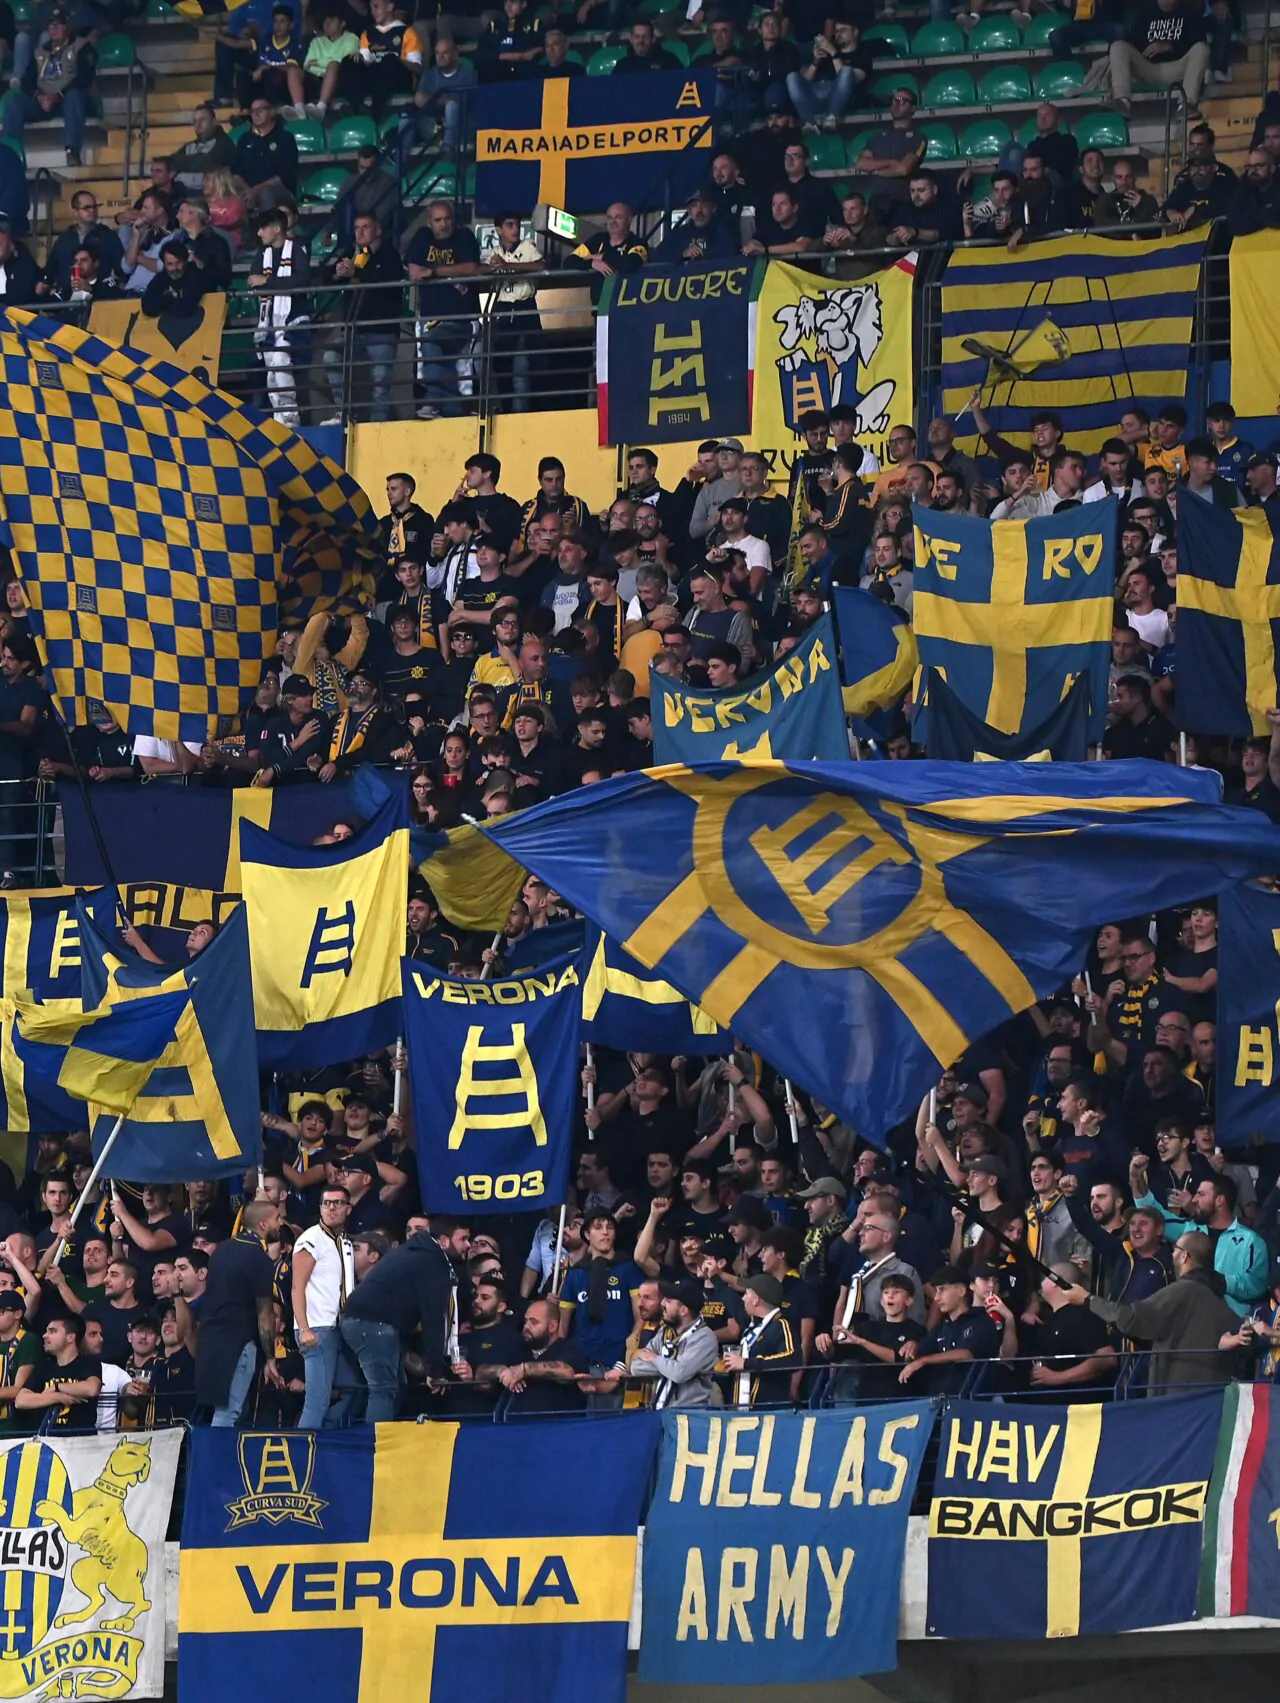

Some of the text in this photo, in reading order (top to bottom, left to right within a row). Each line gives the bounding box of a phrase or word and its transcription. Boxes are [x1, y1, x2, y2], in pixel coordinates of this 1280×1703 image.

[411, 965, 580, 1005] VERONA
[454, 1170, 545, 1201] 1903
[669, 1414, 919, 1508] HELLAS
[247, 1497, 306, 1511] CURVA SUD
[937, 1484, 1204, 1538] BANGKOK
[235, 1555, 580, 1614] VERONA
[676, 1544, 855, 1642] ARMY
[22, 1635, 130, 1687] VERONA
